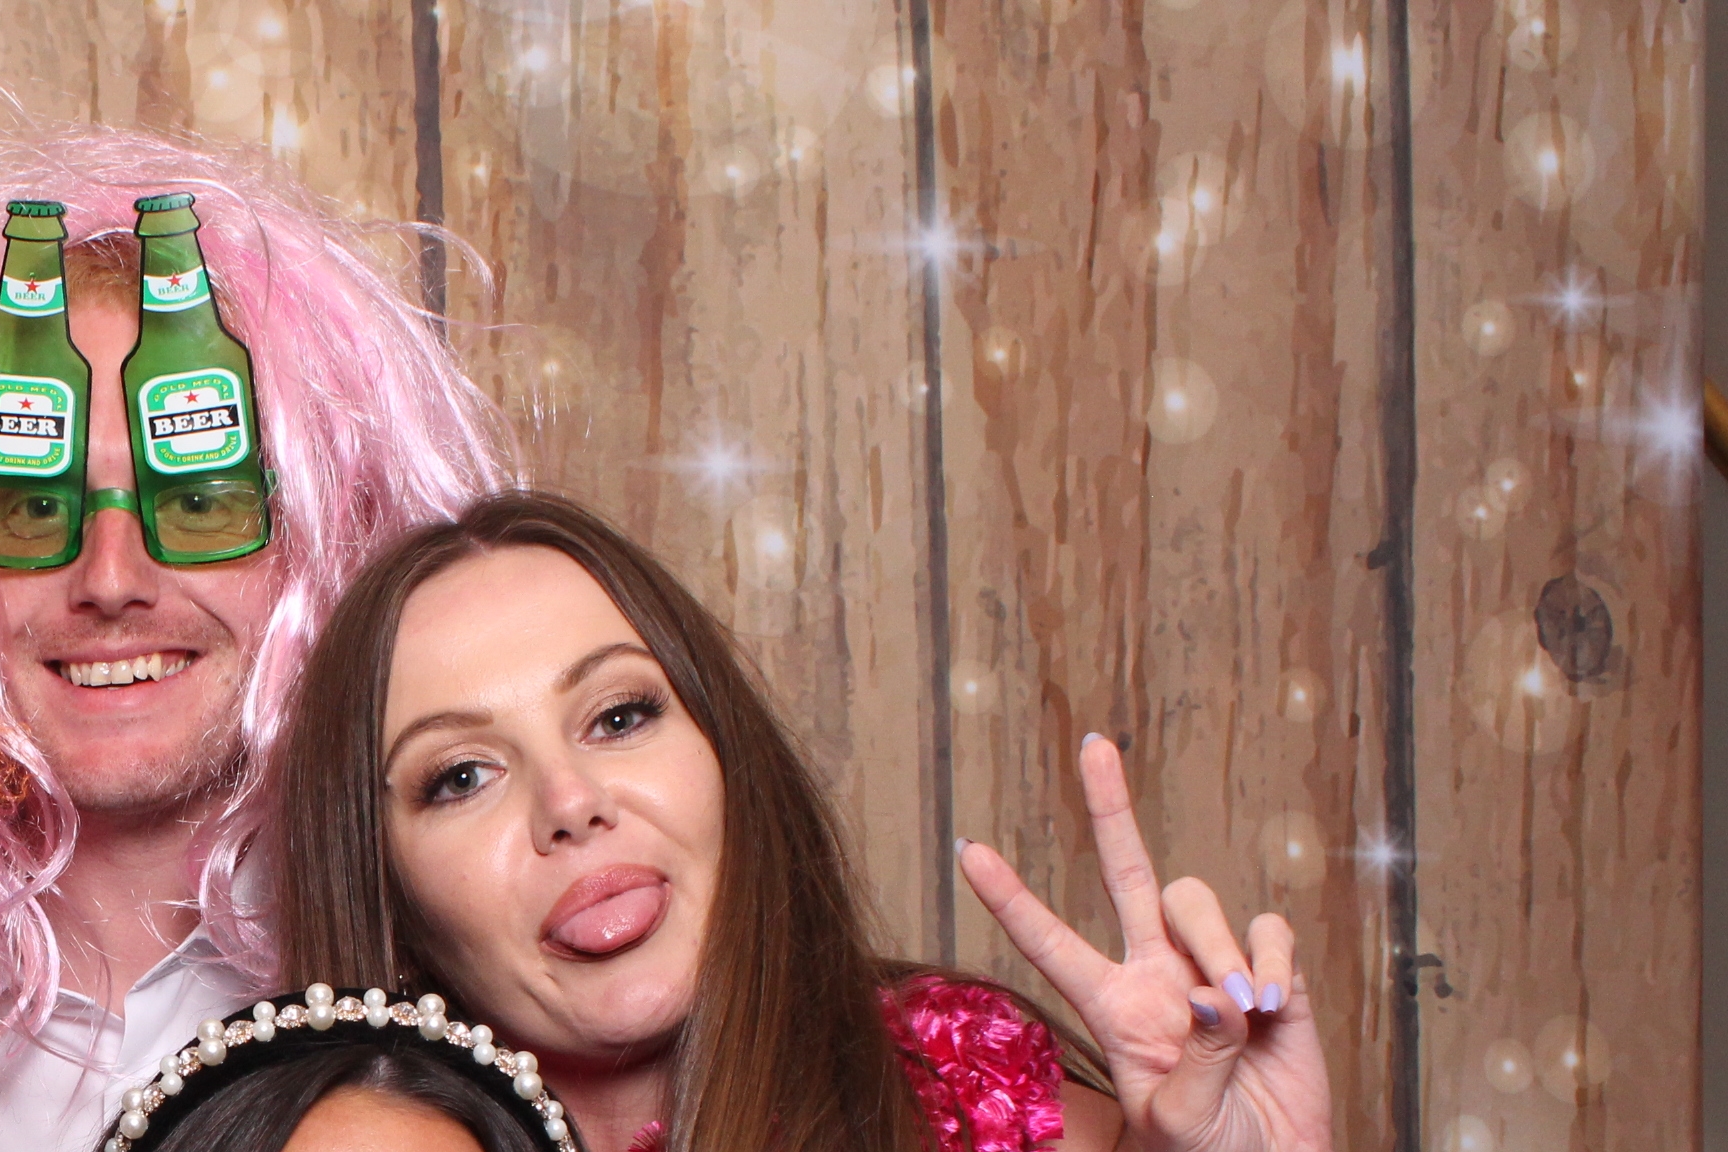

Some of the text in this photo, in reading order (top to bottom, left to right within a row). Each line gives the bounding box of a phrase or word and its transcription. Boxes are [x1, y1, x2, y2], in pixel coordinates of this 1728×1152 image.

[14, 291, 46, 300] BEER
[158, 284, 190, 295] BEER
[30, 386, 63, 410] MEDAL
[154, 378, 229, 402] GOLD MEDAL
[153, 408, 233, 436] BEER
[4, 456, 26, 465] DRINK
[27, 458, 41, 466] AND
[43, 447, 61, 465] DRIVE
[160, 435, 237, 463] DON'T DRINK AND DRIVE
